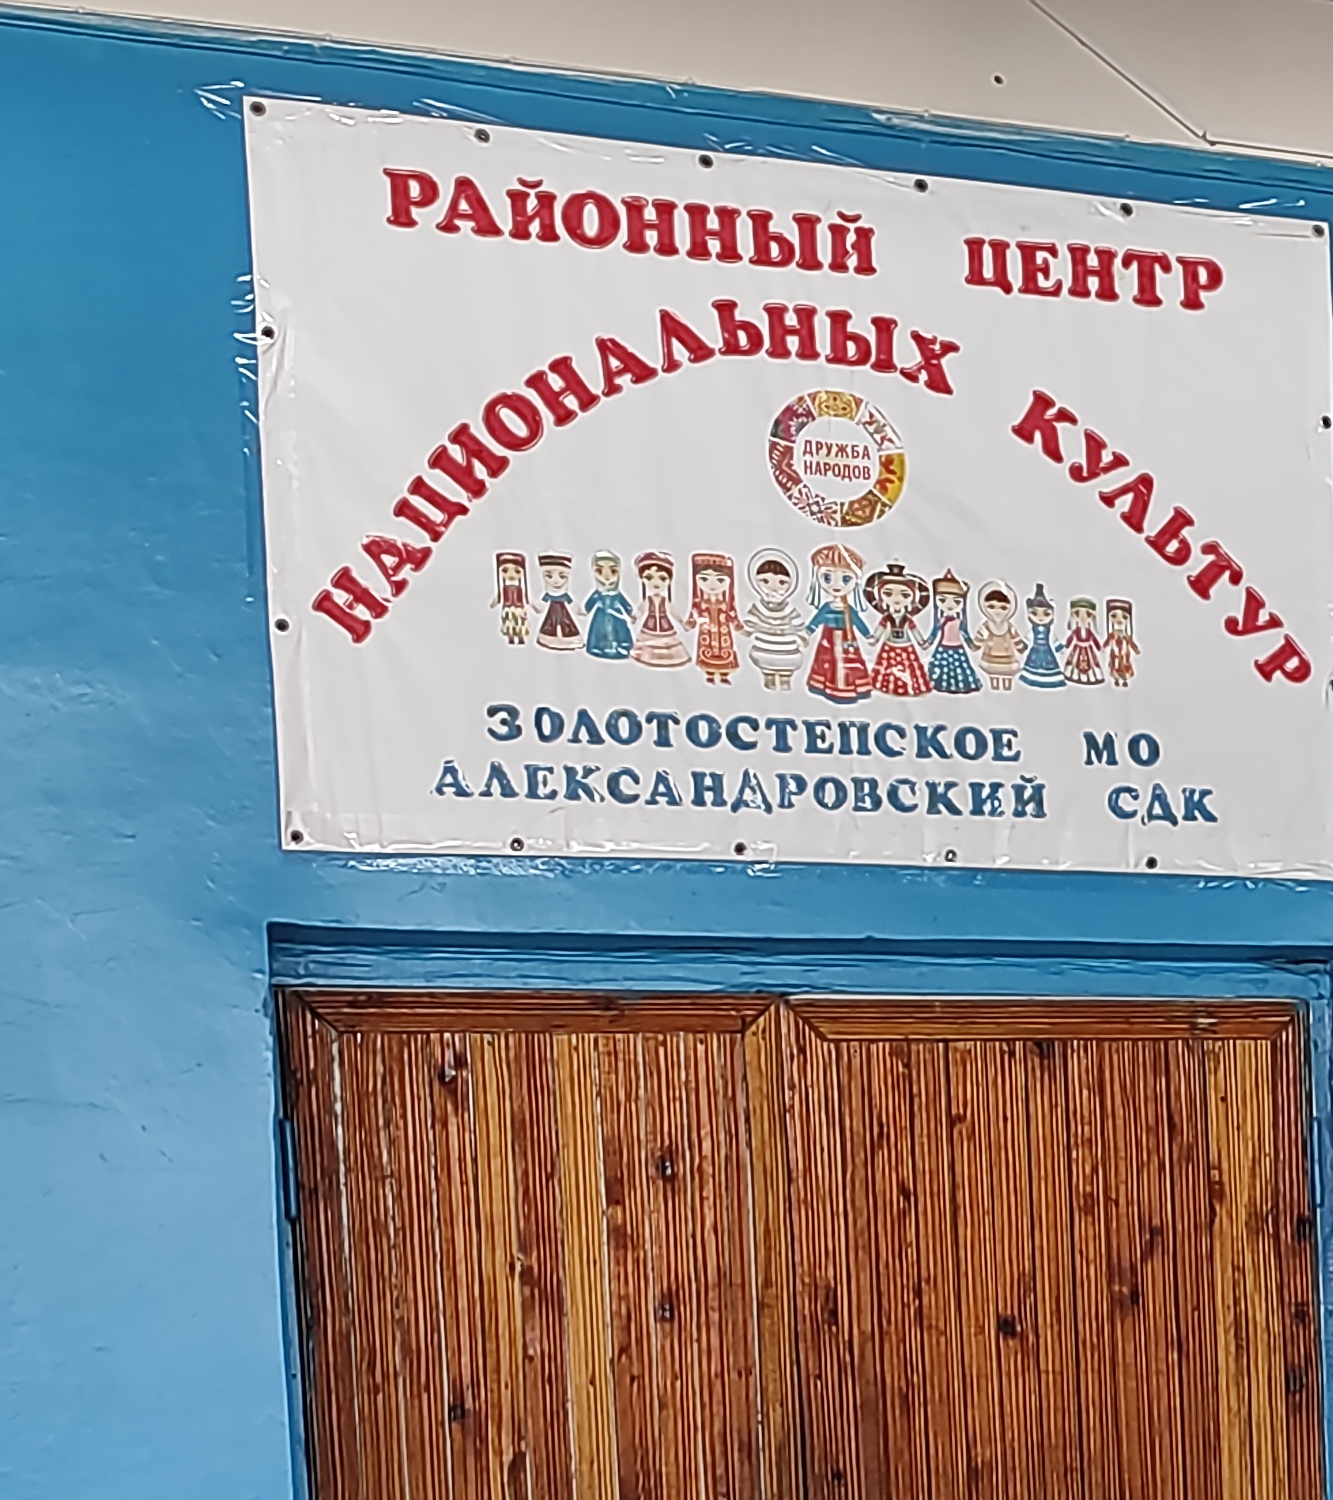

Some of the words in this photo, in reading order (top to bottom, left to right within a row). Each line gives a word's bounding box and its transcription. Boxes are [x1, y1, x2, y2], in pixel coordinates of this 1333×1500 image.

[384, 168, 877, 276] РАЙОННЫЙ
[964, 237, 1224, 311] ЦЕНТР
[803, 440, 871, 460] ДРУЖБА
[804, 460, 871, 482] НАРОДОВ
[312, 299, 960, 644] НАЦИОНАЛЬНЫХ
[1011, 390, 1312, 685] КУЛЬТУР
[488, 704, 1021, 762] ЗОЛОТОСТЕПСКОЕ
[1083, 731, 1160, 767] МО
[434, 761, 1045, 819] АЛЕКСАНДРОВСКИЙ
[1108, 783, 1217, 825] СДК
